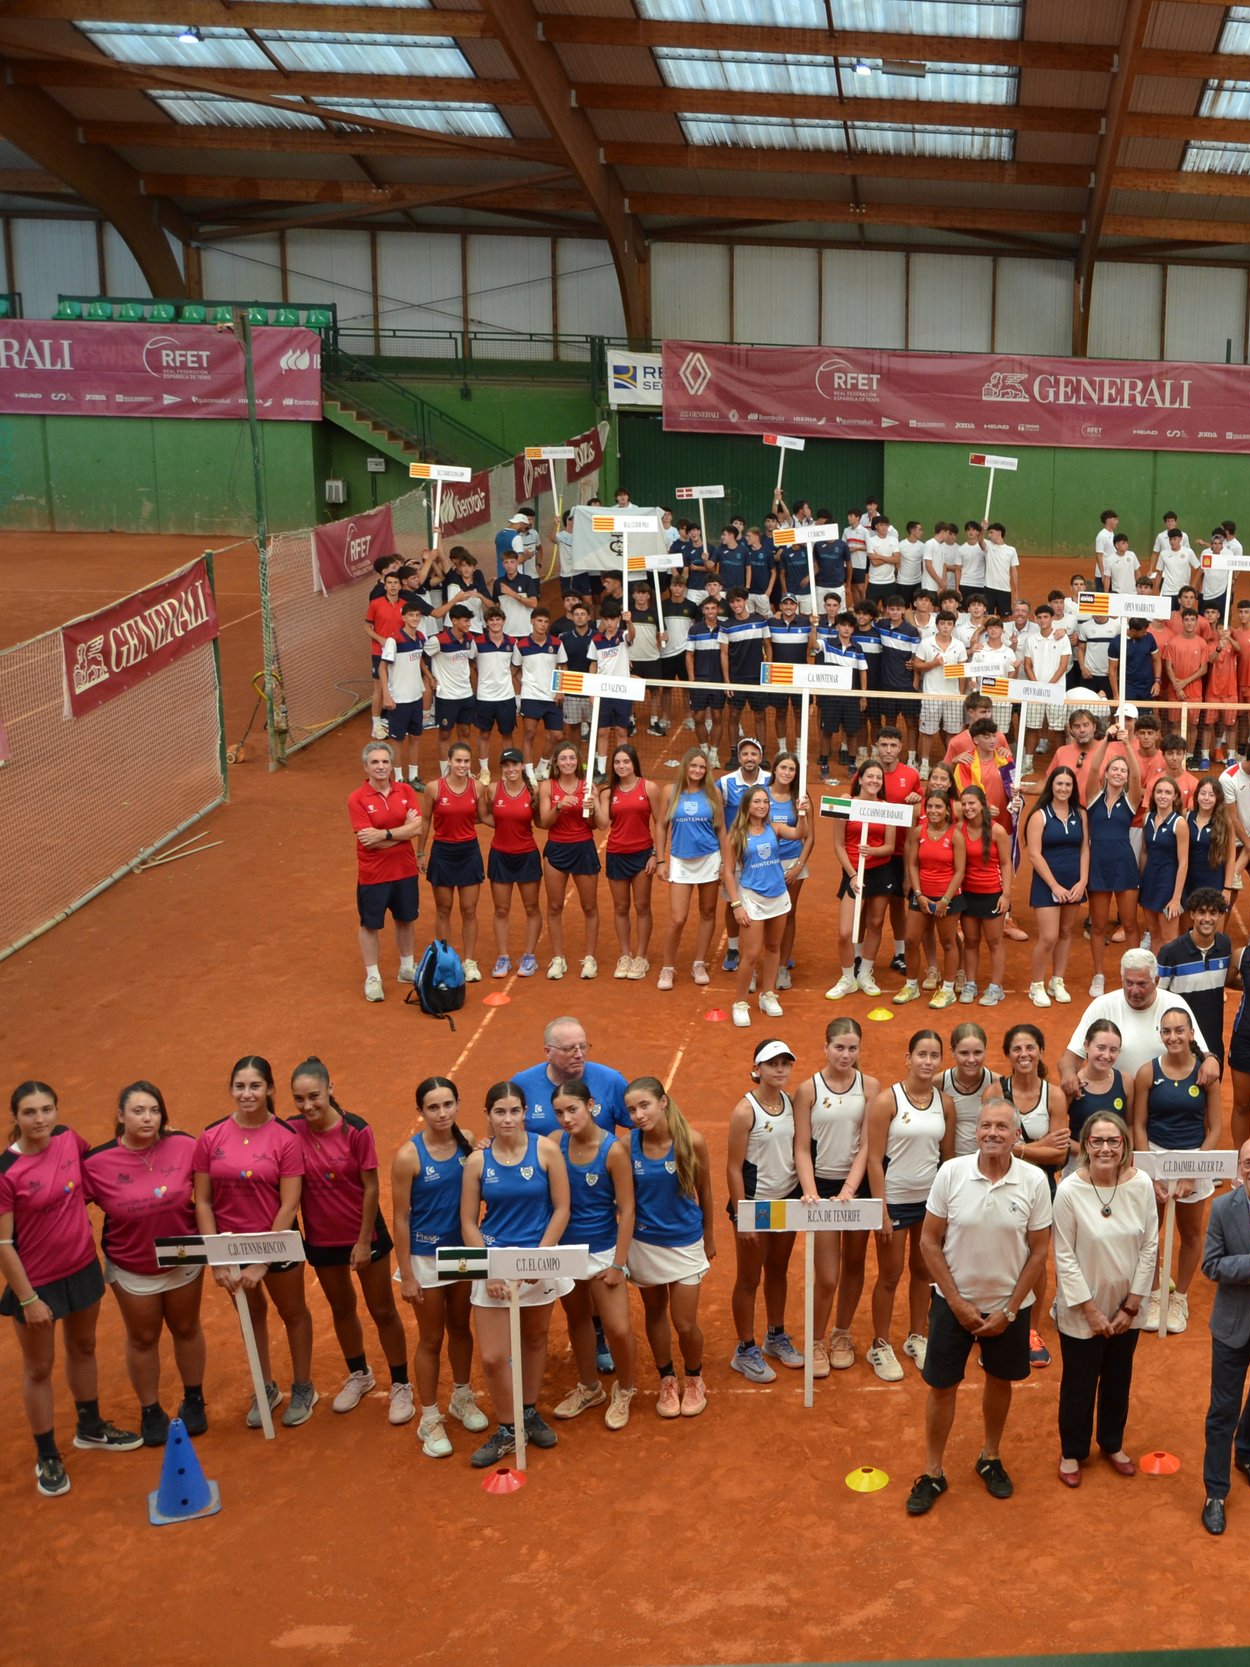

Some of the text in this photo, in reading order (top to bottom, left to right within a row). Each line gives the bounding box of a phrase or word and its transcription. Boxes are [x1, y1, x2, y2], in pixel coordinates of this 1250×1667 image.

[162, 350, 210, 368] RFET
[834, 373, 880, 390] RFET
[1033, 374, 1192, 409] GENERALI
[758, 414, 785, 422] Iberdrola
[351, 535, 372, 561] RFET
[109, 580, 209, 672] GENERALI
[816, 674, 839, 684] MONTEMAR
[1174, 1160, 1195, 1172] DAIMIEL
[1197, 1161, 1215, 1172] AZUER
[807, 1210, 861, 1222] R.C.N. DE TENERIFE
[227, 1241, 287, 1256] C.D. TENNIS RINCON
[516, 1257, 561, 1272] C.T. EL CAMPO
